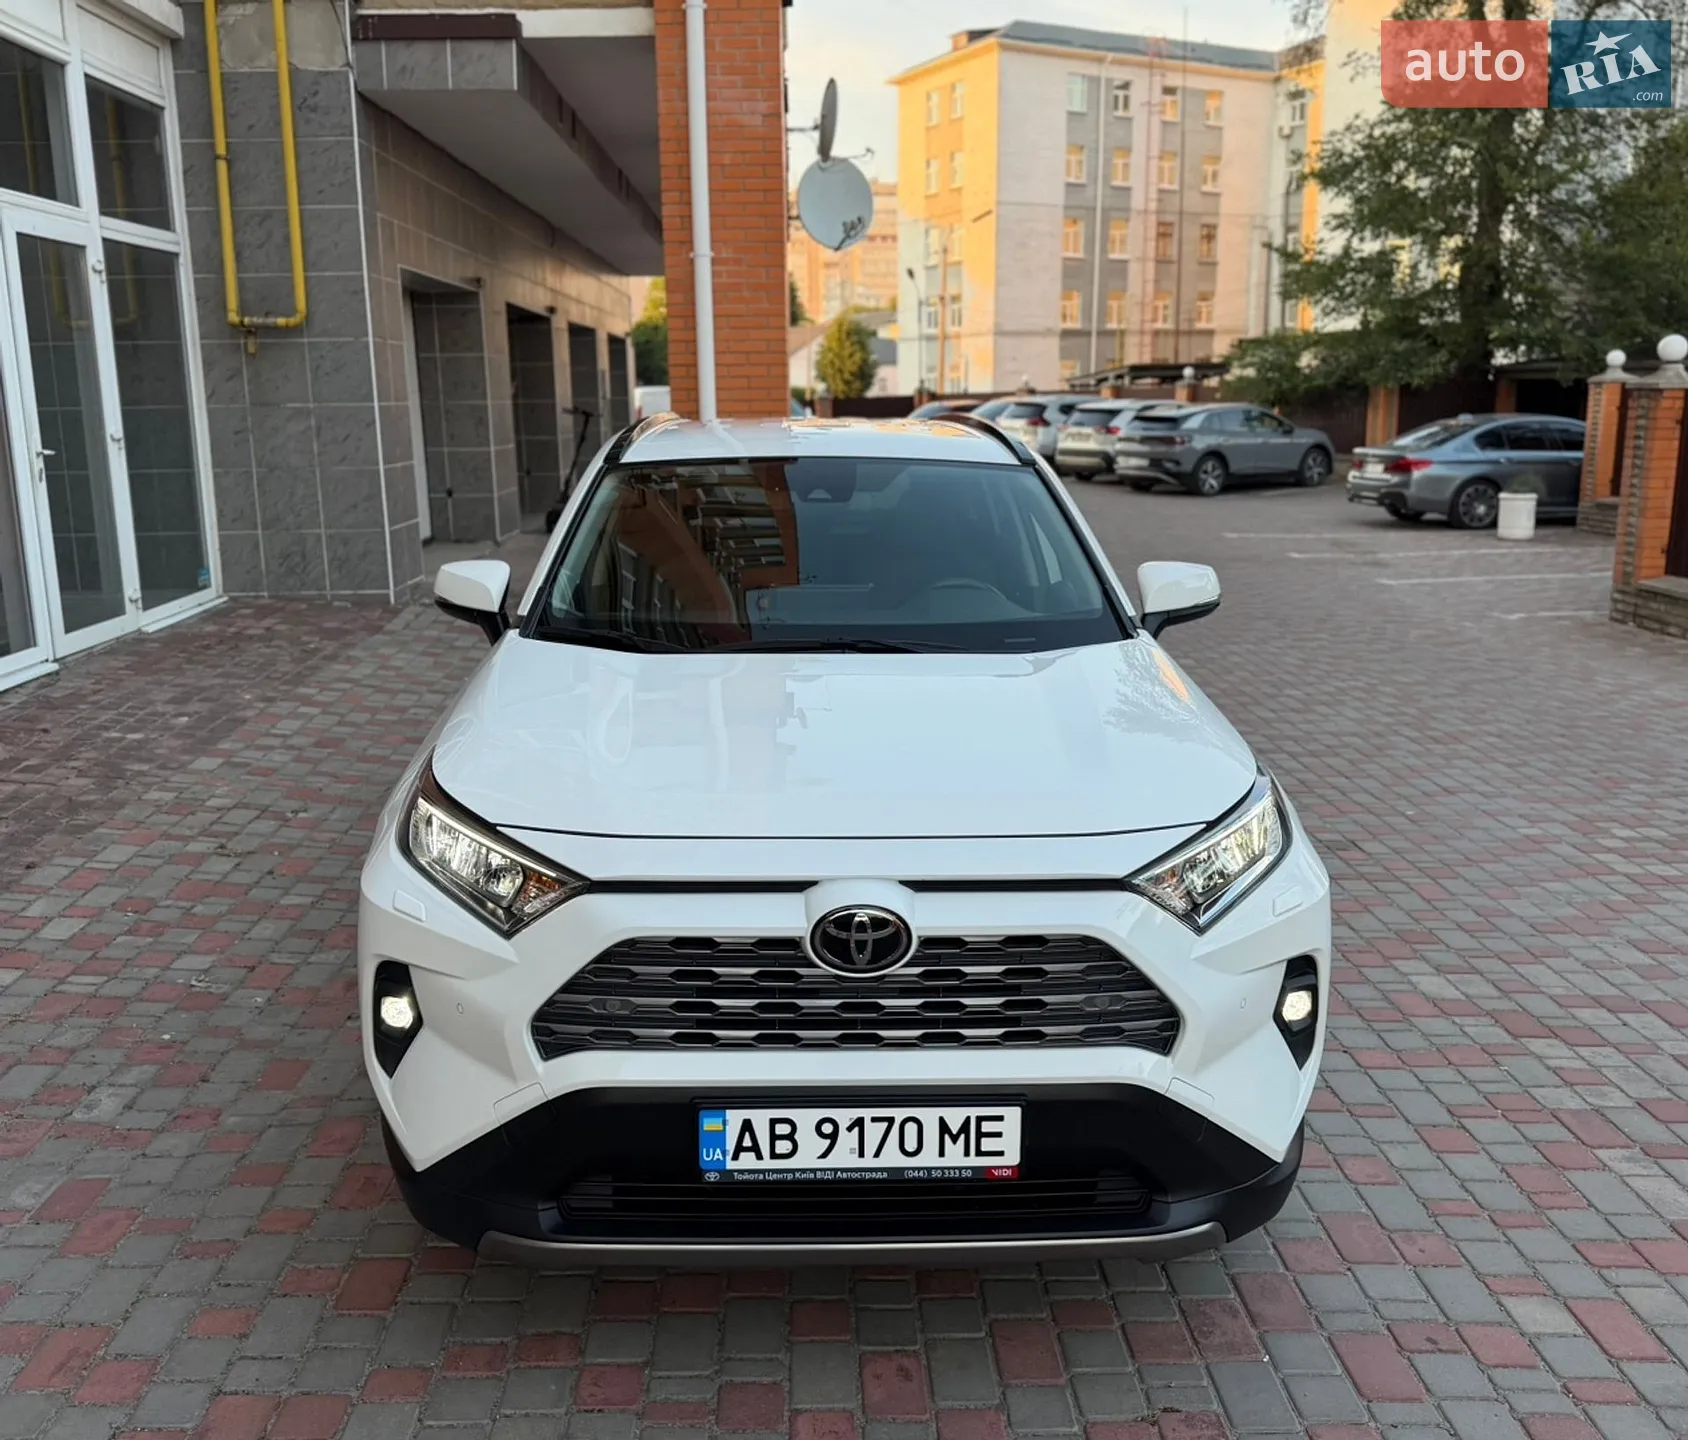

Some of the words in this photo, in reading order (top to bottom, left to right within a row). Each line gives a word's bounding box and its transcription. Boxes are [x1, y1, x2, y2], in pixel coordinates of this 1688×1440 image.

[731, 1117, 799, 1161] AB
[814, 1115, 924, 1160] 9170
[938, 1115, 1005, 1158] ME
[703, 1148, 723, 1161] UA
[733, 1172, 764, 1180] Тойота
[765, 1171, 794, 1181] Центр
[795, 1171, 815, 1179] Київ
[836, 1170, 888, 1179] Автострада
[904, 1170, 928, 1179] (044)
[931, 1170, 943, 1178] 50
[944, 1170, 960, 1178] 333
[961, 1169, 972, 1178] 50
